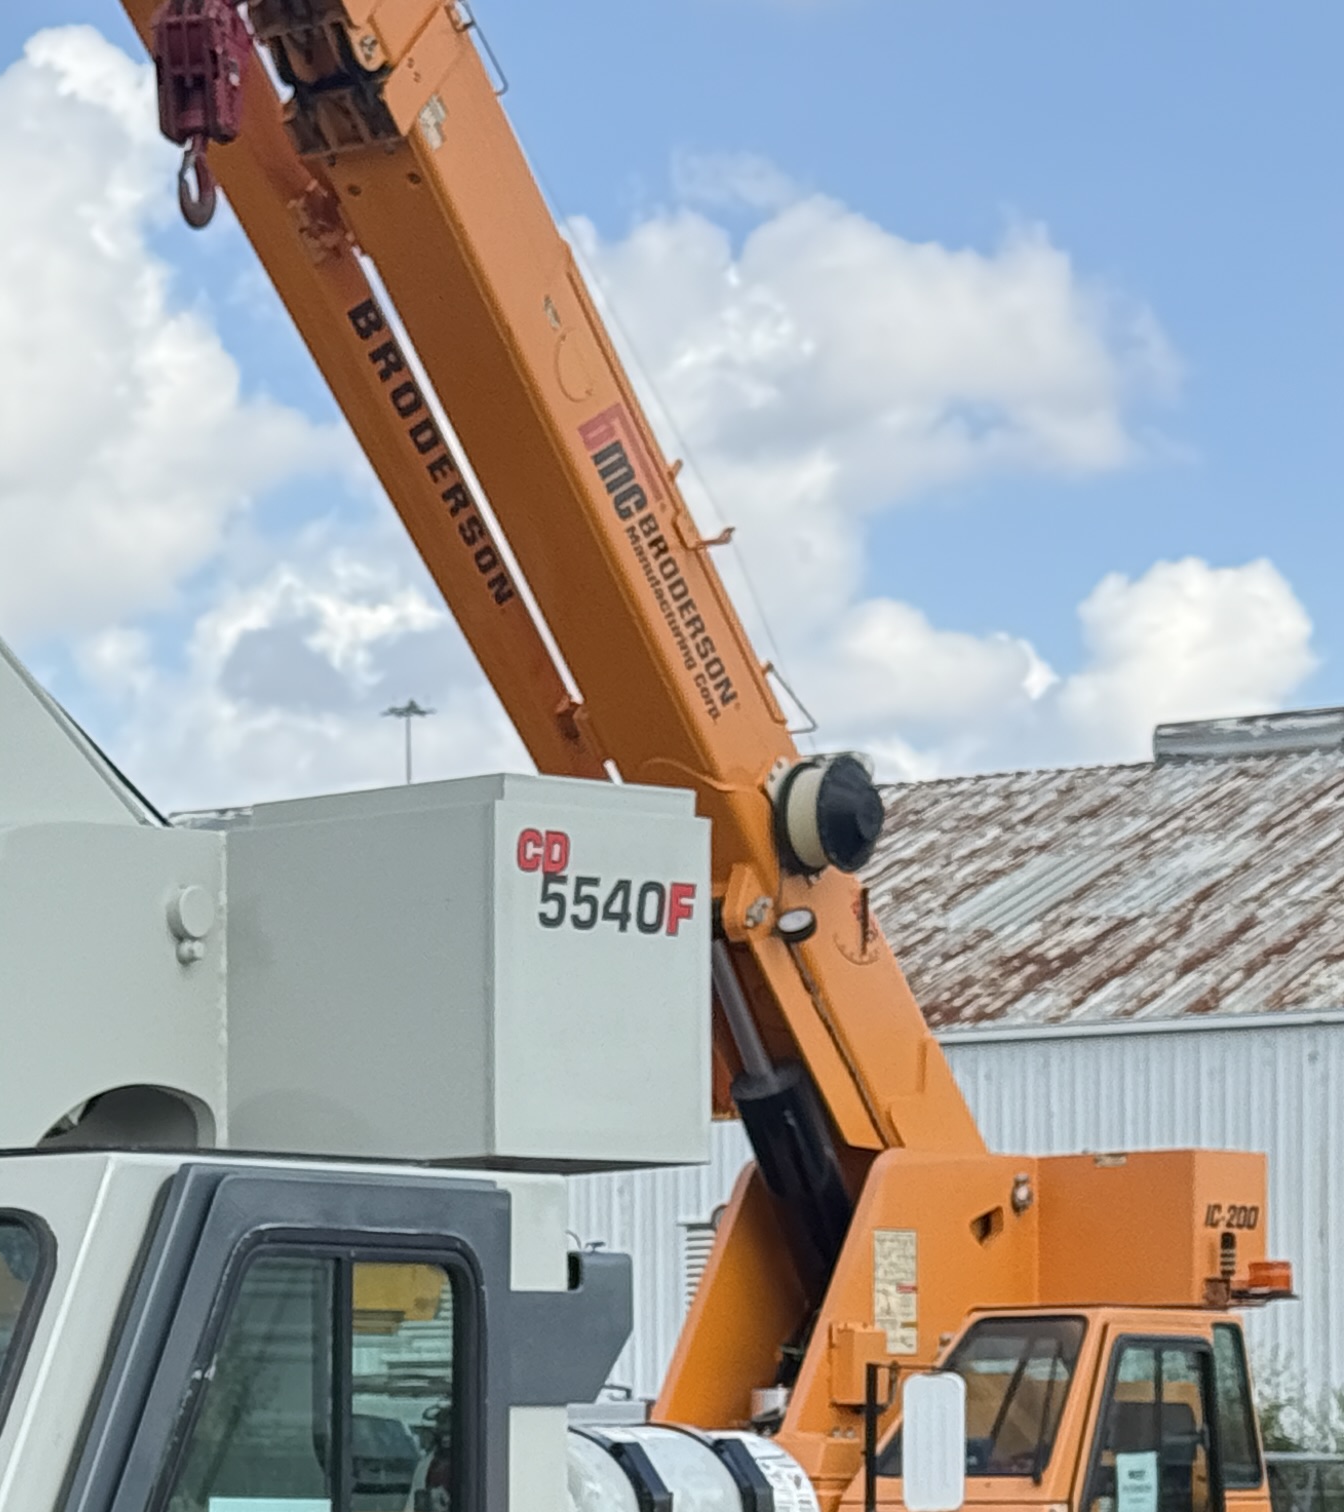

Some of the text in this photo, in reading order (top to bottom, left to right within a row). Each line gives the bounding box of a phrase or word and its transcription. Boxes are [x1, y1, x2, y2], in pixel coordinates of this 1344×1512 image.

[347, 298, 514, 606] BRODERSON
[624, 524, 697, 672] Manufacturing
[637, 512, 738, 708] BRODERSON
[517, 827, 571, 875] CD
[538, 872, 698, 937] 5540F
[1204, 1203, 1260, 1230] IC-200
